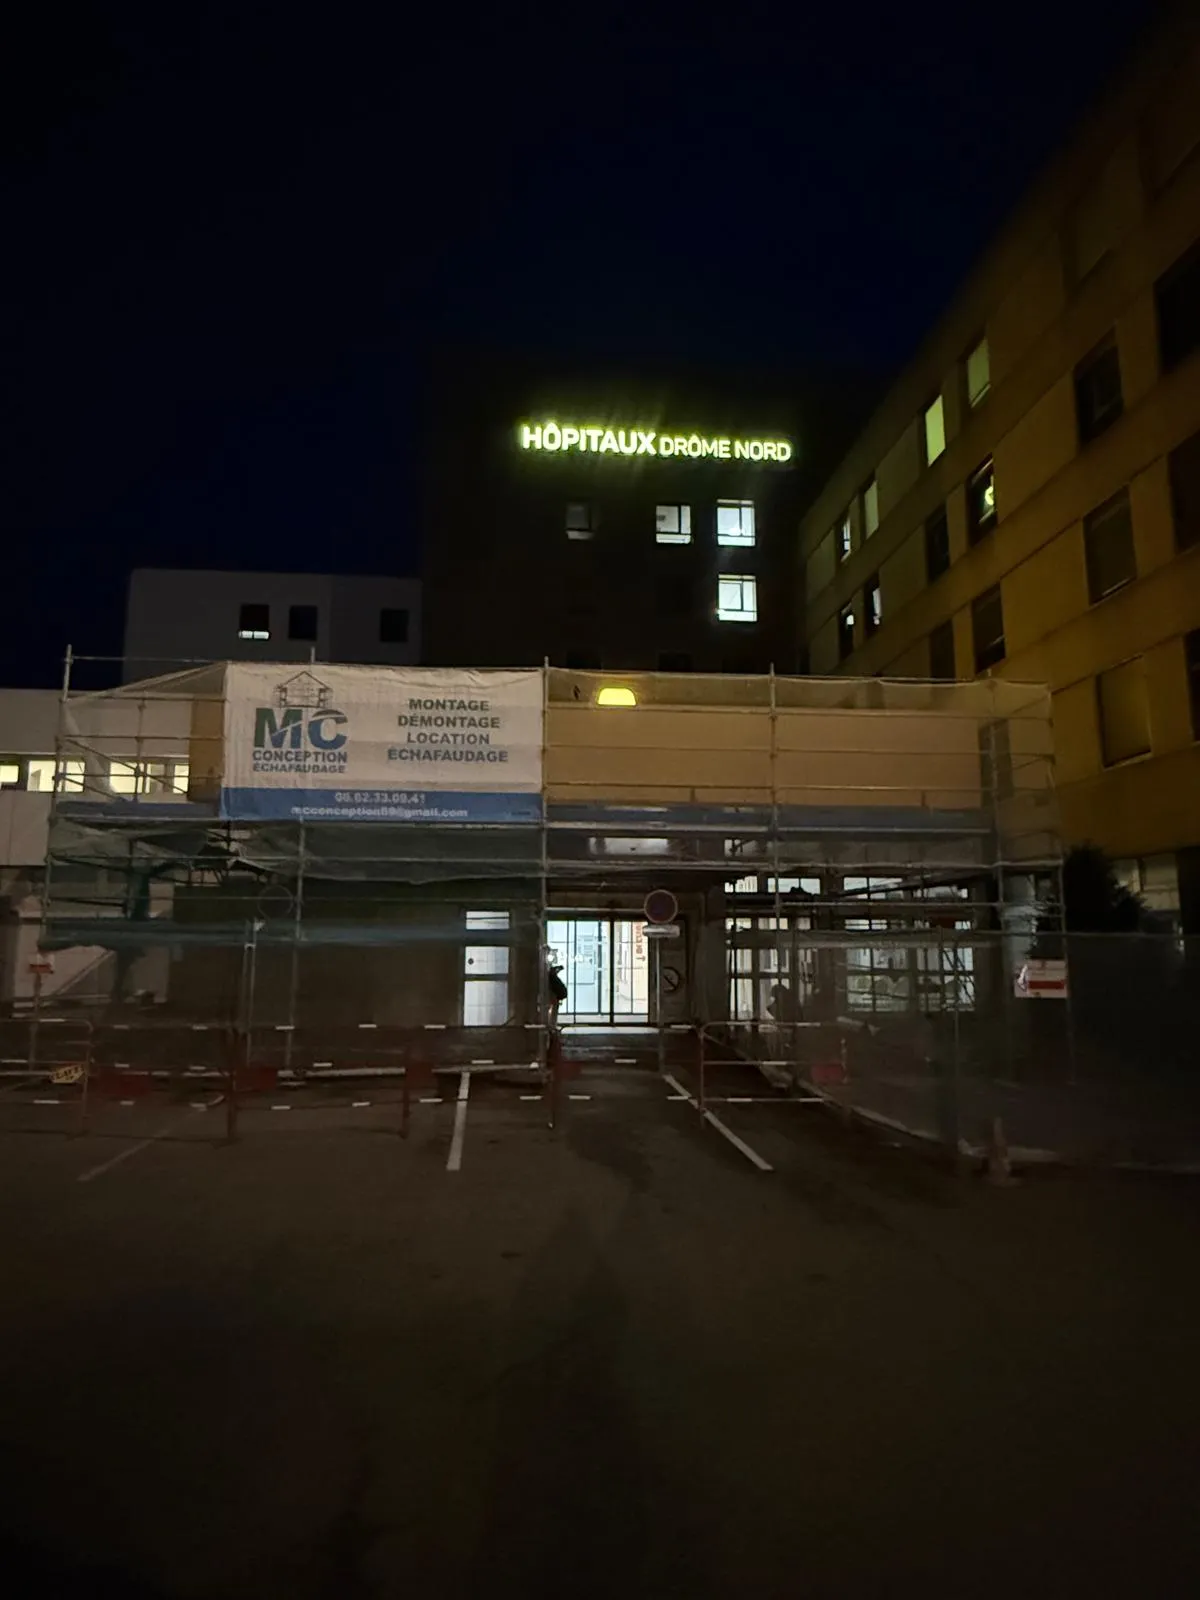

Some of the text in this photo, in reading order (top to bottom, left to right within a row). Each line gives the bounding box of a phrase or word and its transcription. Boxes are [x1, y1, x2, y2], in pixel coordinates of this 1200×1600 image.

[521, 422, 792, 462] HÔPITAUX DRÔME NORD
[408, 698, 490, 712] MONTAGE
[254, 707, 348, 751] MC
[397, 713, 501, 729] DÉMONTAGE
[406, 732, 490, 745] LOCATION
[252, 750, 348, 763] CONCEPTION
[386, 746, 509, 763] ÉCHAFAUDAGE
